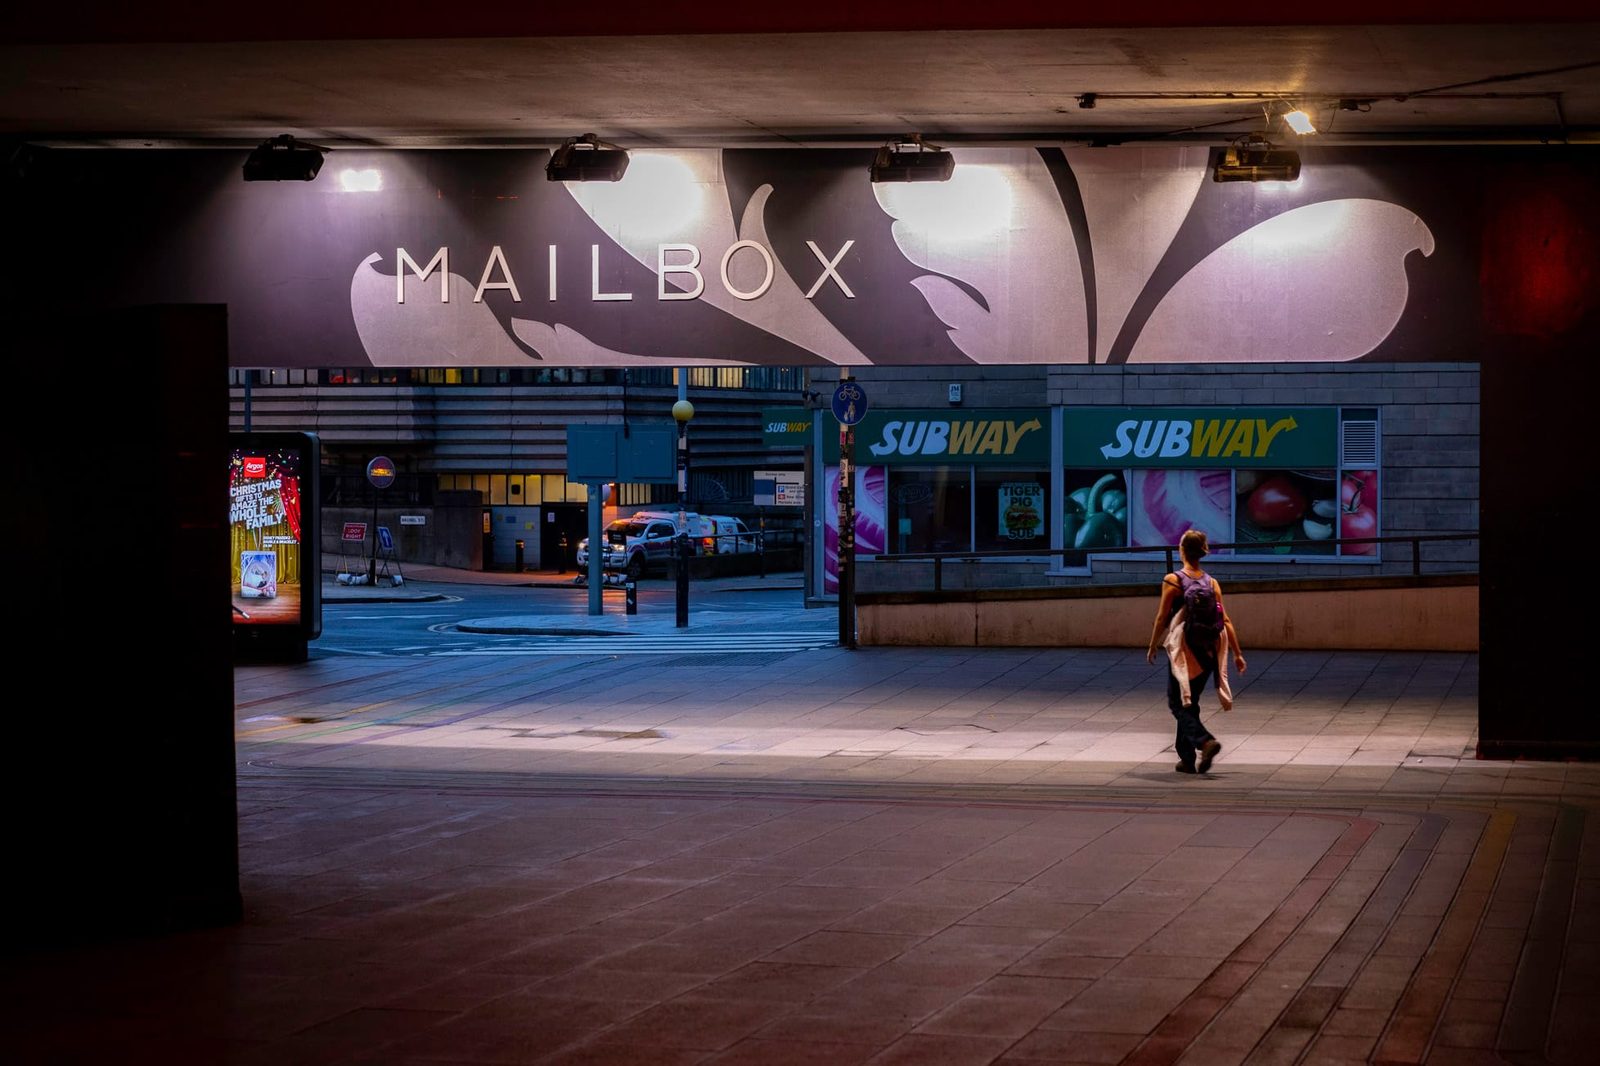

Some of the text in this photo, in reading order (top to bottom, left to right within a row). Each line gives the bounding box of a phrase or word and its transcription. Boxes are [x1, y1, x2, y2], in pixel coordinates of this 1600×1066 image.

[396, 239, 856, 303] MAILBOX
[765, 422, 811, 432] SUBWAY
[869, 418, 1042, 456] SUBWAY
[1101, 415, 1297, 460] SUBWAY
[245, 462, 264, 470] Argos
[230, 480, 281, 497] CHRISTMAS
[1002, 486, 1040, 496] TIGER
[231, 496, 274, 512] AMAZE THE
[235, 492, 263, 502] GIFTS TO
[1010, 497, 1033, 507] PIG
[229, 505, 268, 525] WHOLE
[246, 513, 283, 530] FAMILY
[1008, 528, 1035, 539] SUB
